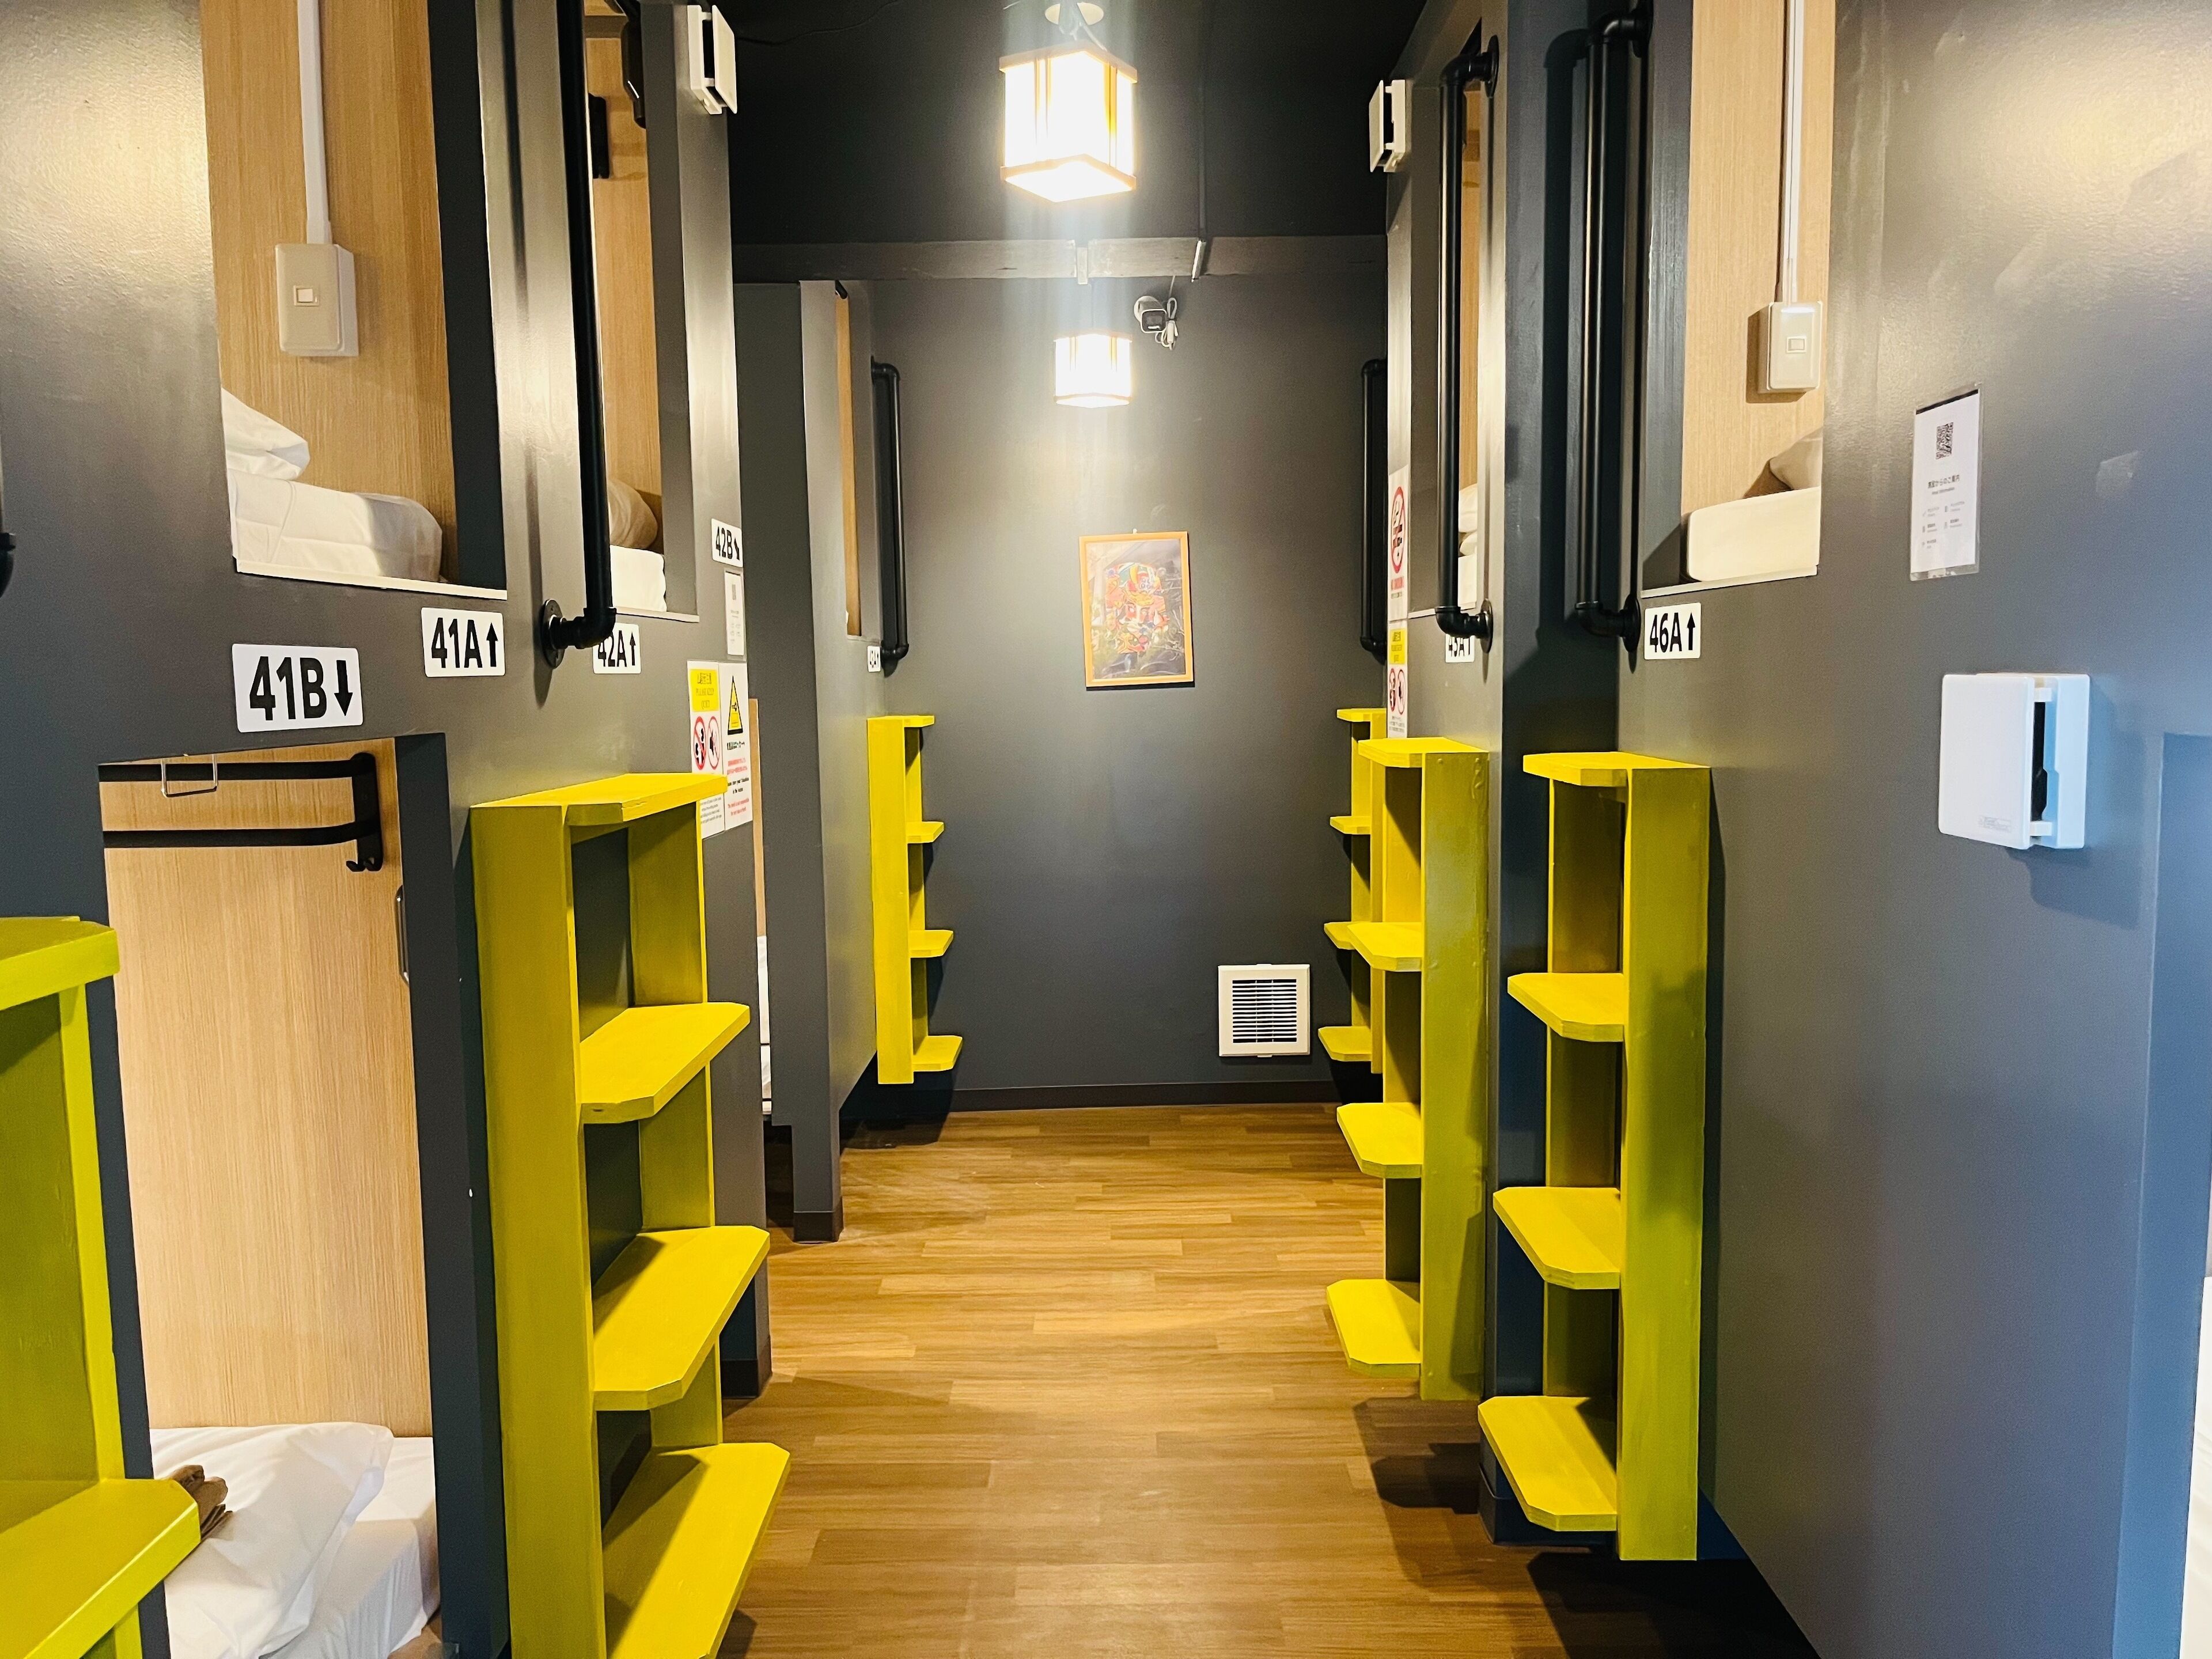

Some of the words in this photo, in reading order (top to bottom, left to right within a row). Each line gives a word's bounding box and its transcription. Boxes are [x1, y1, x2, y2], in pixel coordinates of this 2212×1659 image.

[715, 526, 733, 559] 42B
[431, 617, 483, 669] 41A
[597, 630, 627, 667] 42A
[1650, 612, 1682, 653] 46A
[249, 656, 327, 721] 41B
